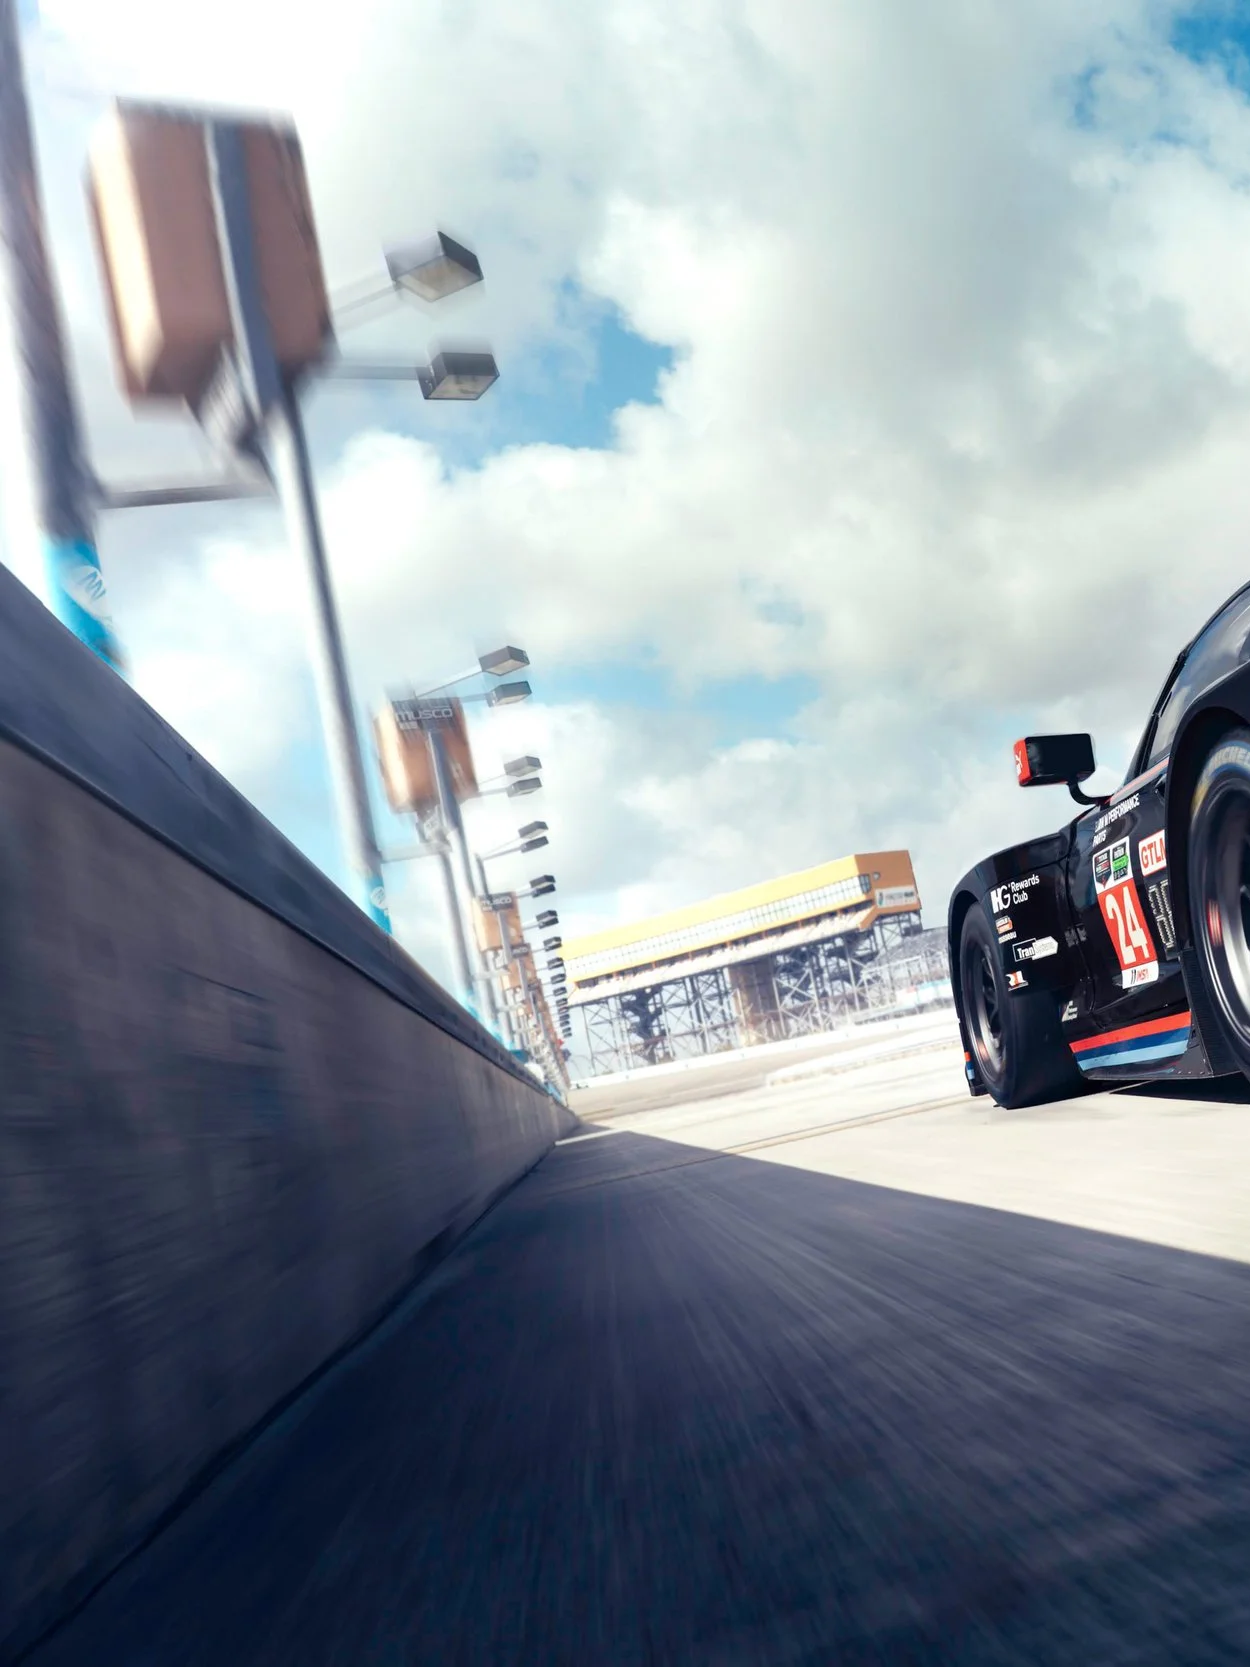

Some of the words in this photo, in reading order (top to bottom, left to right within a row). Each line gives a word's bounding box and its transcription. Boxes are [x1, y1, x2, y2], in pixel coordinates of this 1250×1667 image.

[1011, 874, 1040, 893] Rewards
[1012, 891, 1029, 905] Club
[1105, 885, 1150, 965] 24
